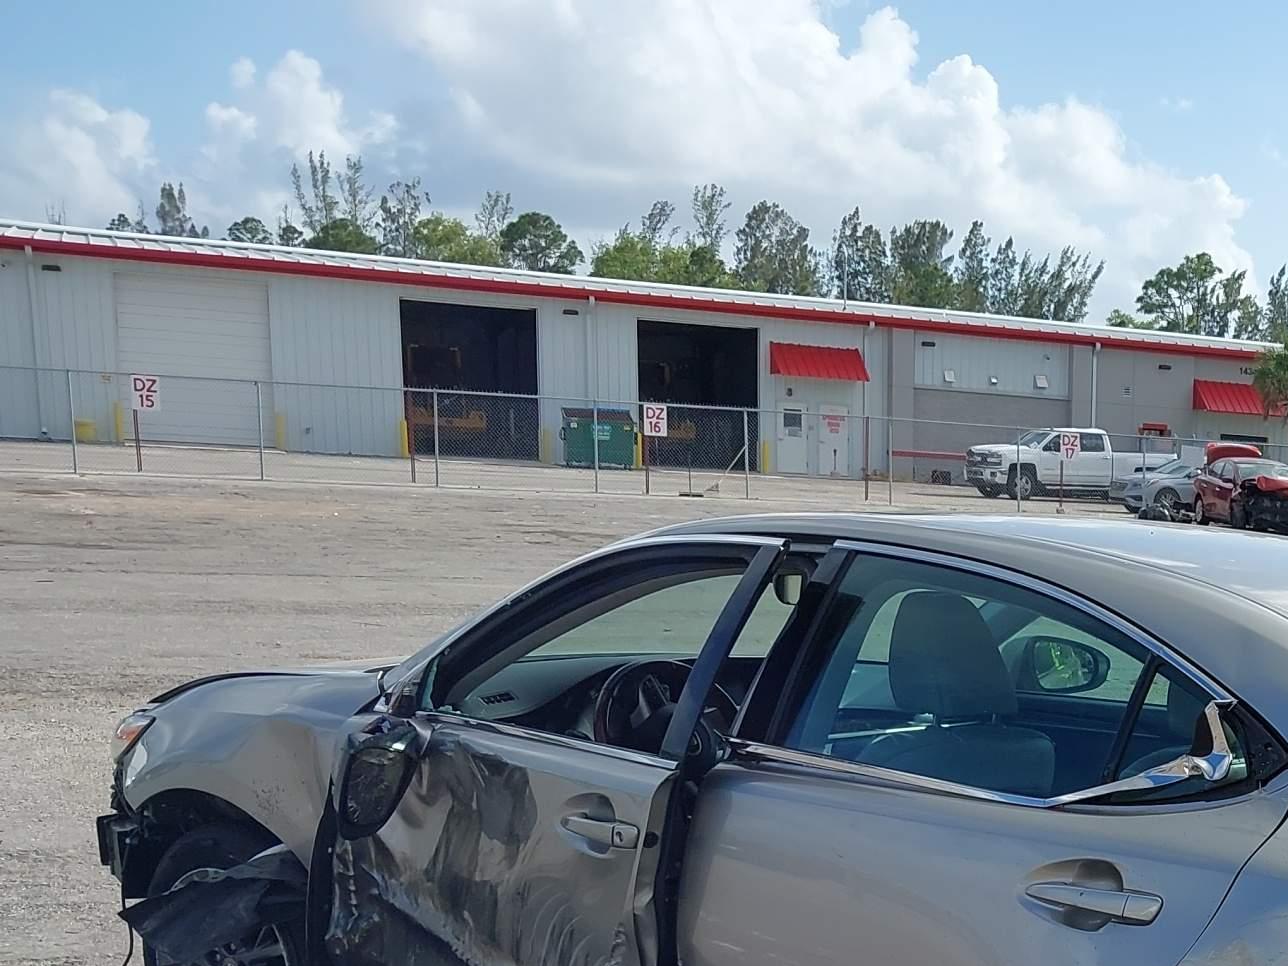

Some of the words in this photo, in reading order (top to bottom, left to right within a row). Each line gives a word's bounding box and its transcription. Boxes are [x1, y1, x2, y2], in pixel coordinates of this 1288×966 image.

[133, 377, 157, 393] DZ
[139, 394, 155, 408] 15
[646, 407, 665, 420] DZ
[648, 421, 662, 433] 16
[1062, 434, 1078, 447] DZ
[1065, 447, 1075, 459] 17
